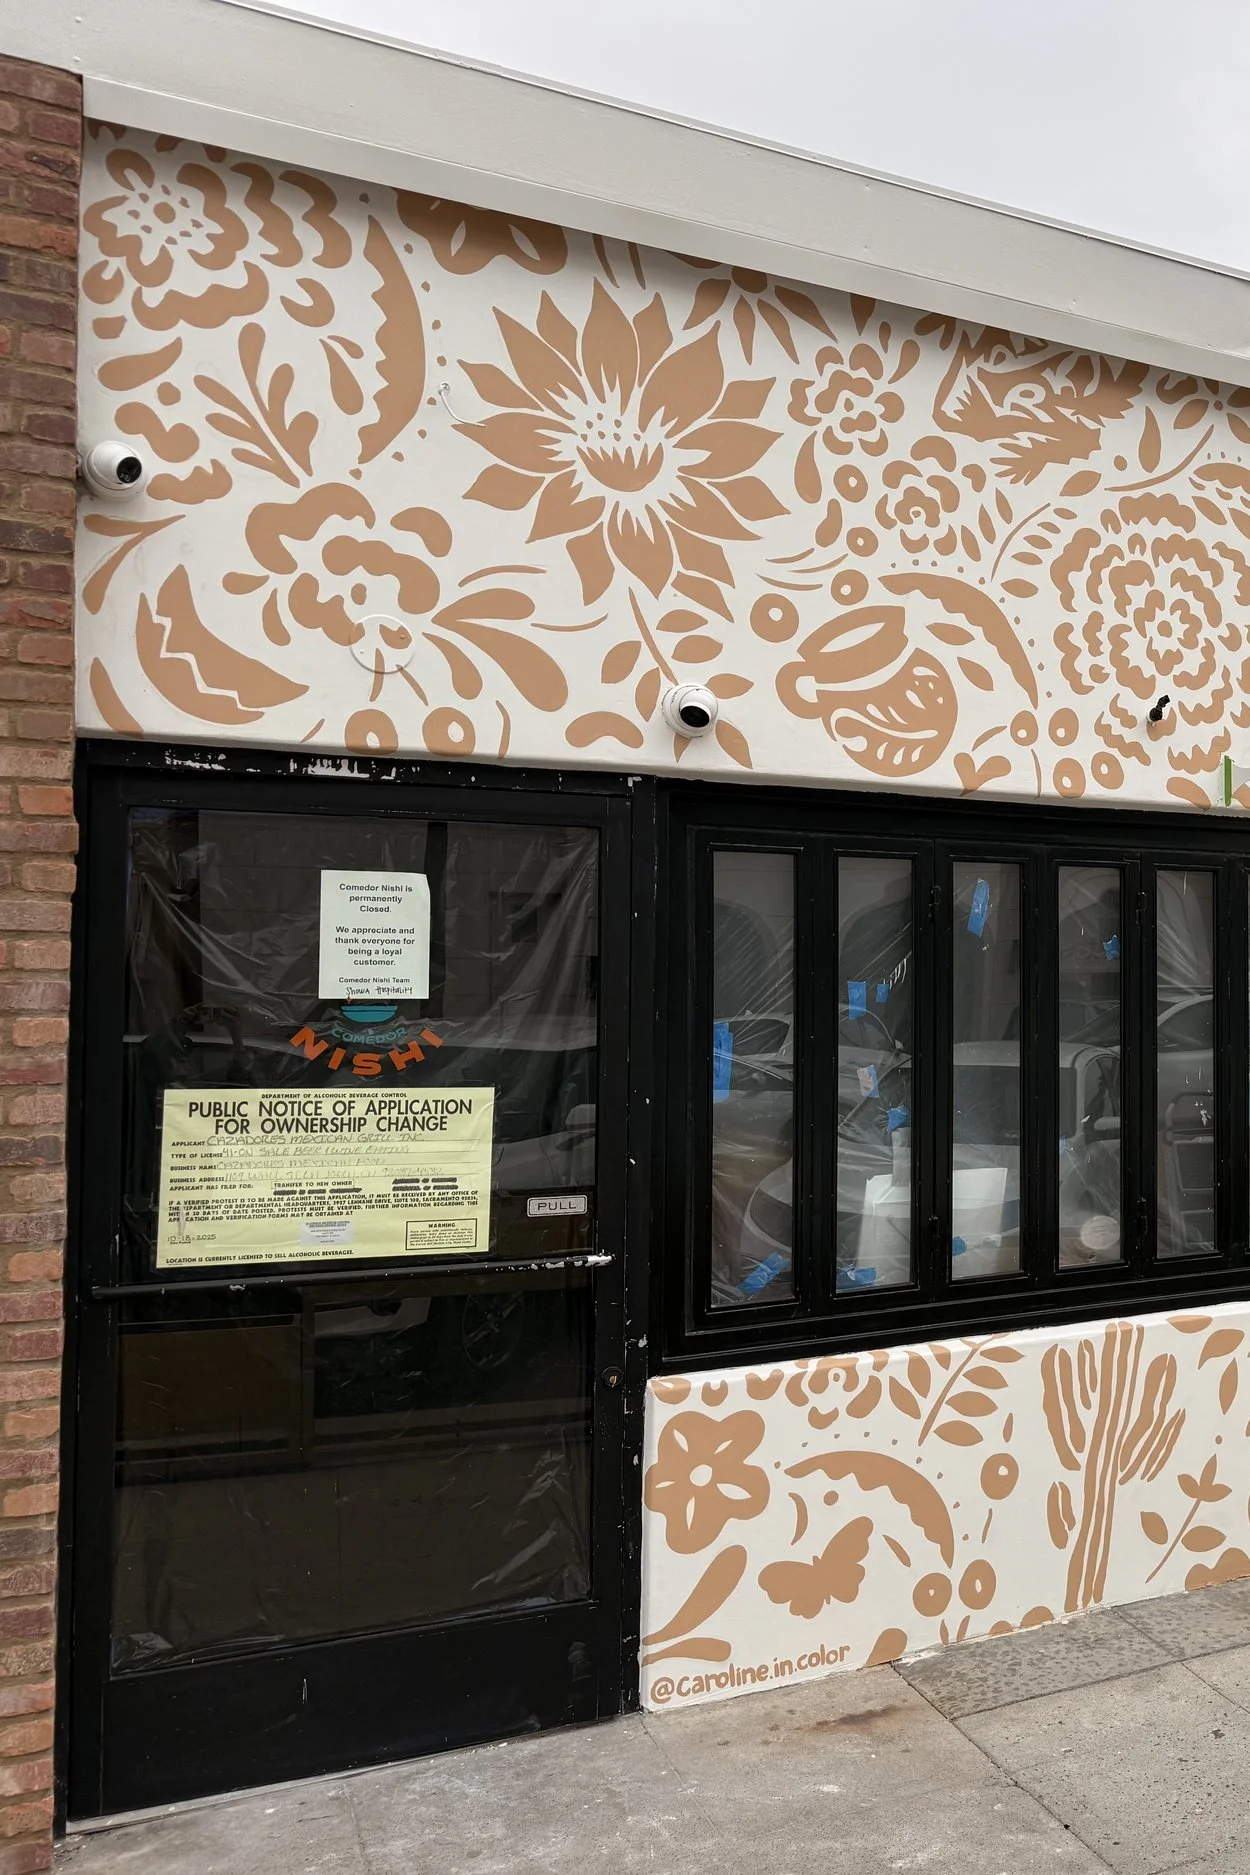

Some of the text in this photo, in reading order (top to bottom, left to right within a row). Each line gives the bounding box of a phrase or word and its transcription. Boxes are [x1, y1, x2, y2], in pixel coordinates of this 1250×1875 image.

[339, 883, 413, 892] Comedor Nishi is
[349, 894, 402, 904] permanently
[360, 905, 392, 913] Closed.
[335, 926, 350, 934] We
[351, 926, 397, 935] appreciate
[361, 938, 401, 946] everyone
[403, 937, 415, 945] for
[348, 948, 372, 957] being
[382, 948, 402, 957] loyal
[353, 959, 396, 967] customer.
[331, 1027, 408, 1044] COMEDOR
[289, 1026, 444, 1076] NISHI
[188, 1099, 472, 1118] PUBLIC NOTICE OF APPLICATION
[215, 1115, 448, 1135] FOR OWNERSHIP CHANGE
[537, 1201, 577, 1211] PULL
[650, 1643, 851, 1705] @caroline.in.color
